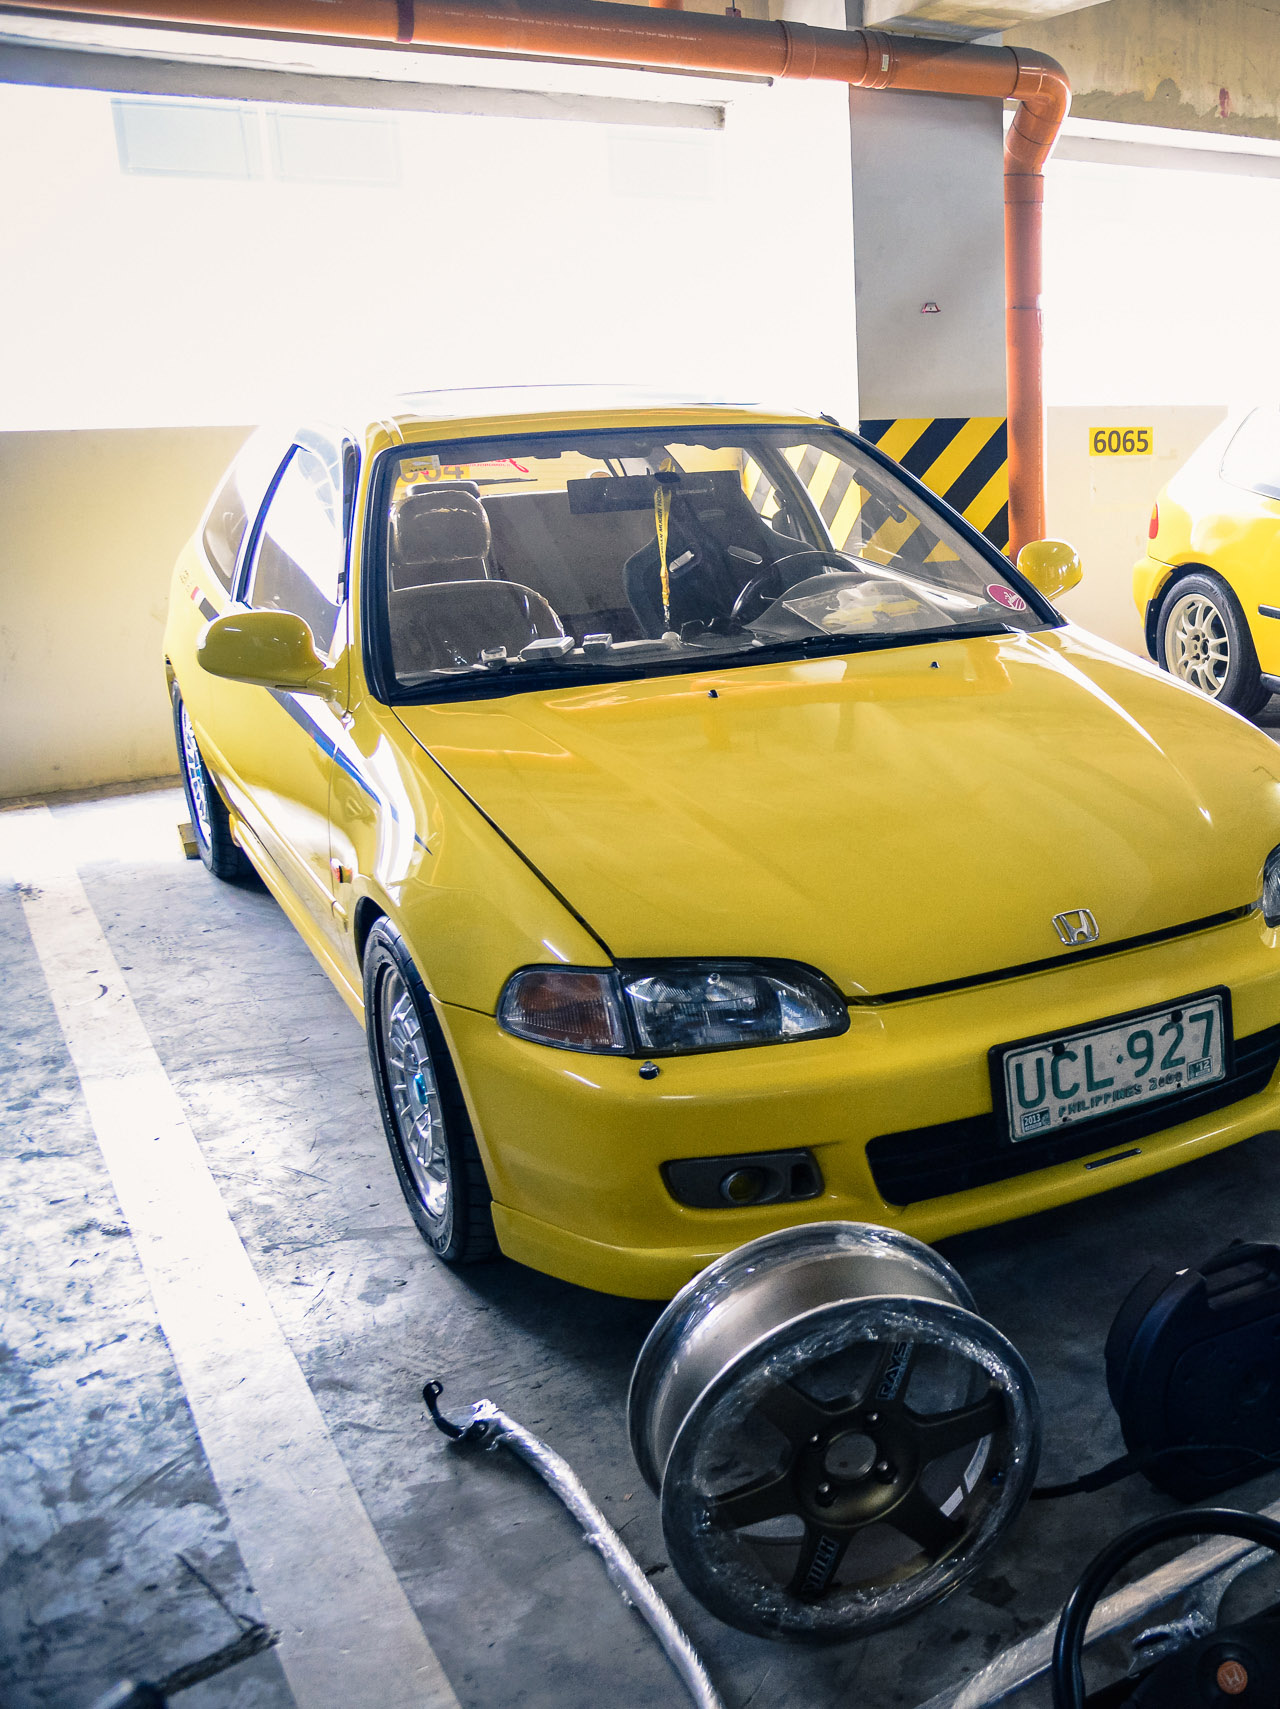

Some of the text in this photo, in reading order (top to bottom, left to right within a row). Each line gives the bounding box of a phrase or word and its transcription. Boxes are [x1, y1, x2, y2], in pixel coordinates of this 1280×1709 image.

[1093, 430, 1149, 453] 6065
[1058, 1083, 1144, 1118] PHILIPPINES
[1024, 1113, 1041, 1127] 2013
[878, 1339, 909, 1399] RAYS
